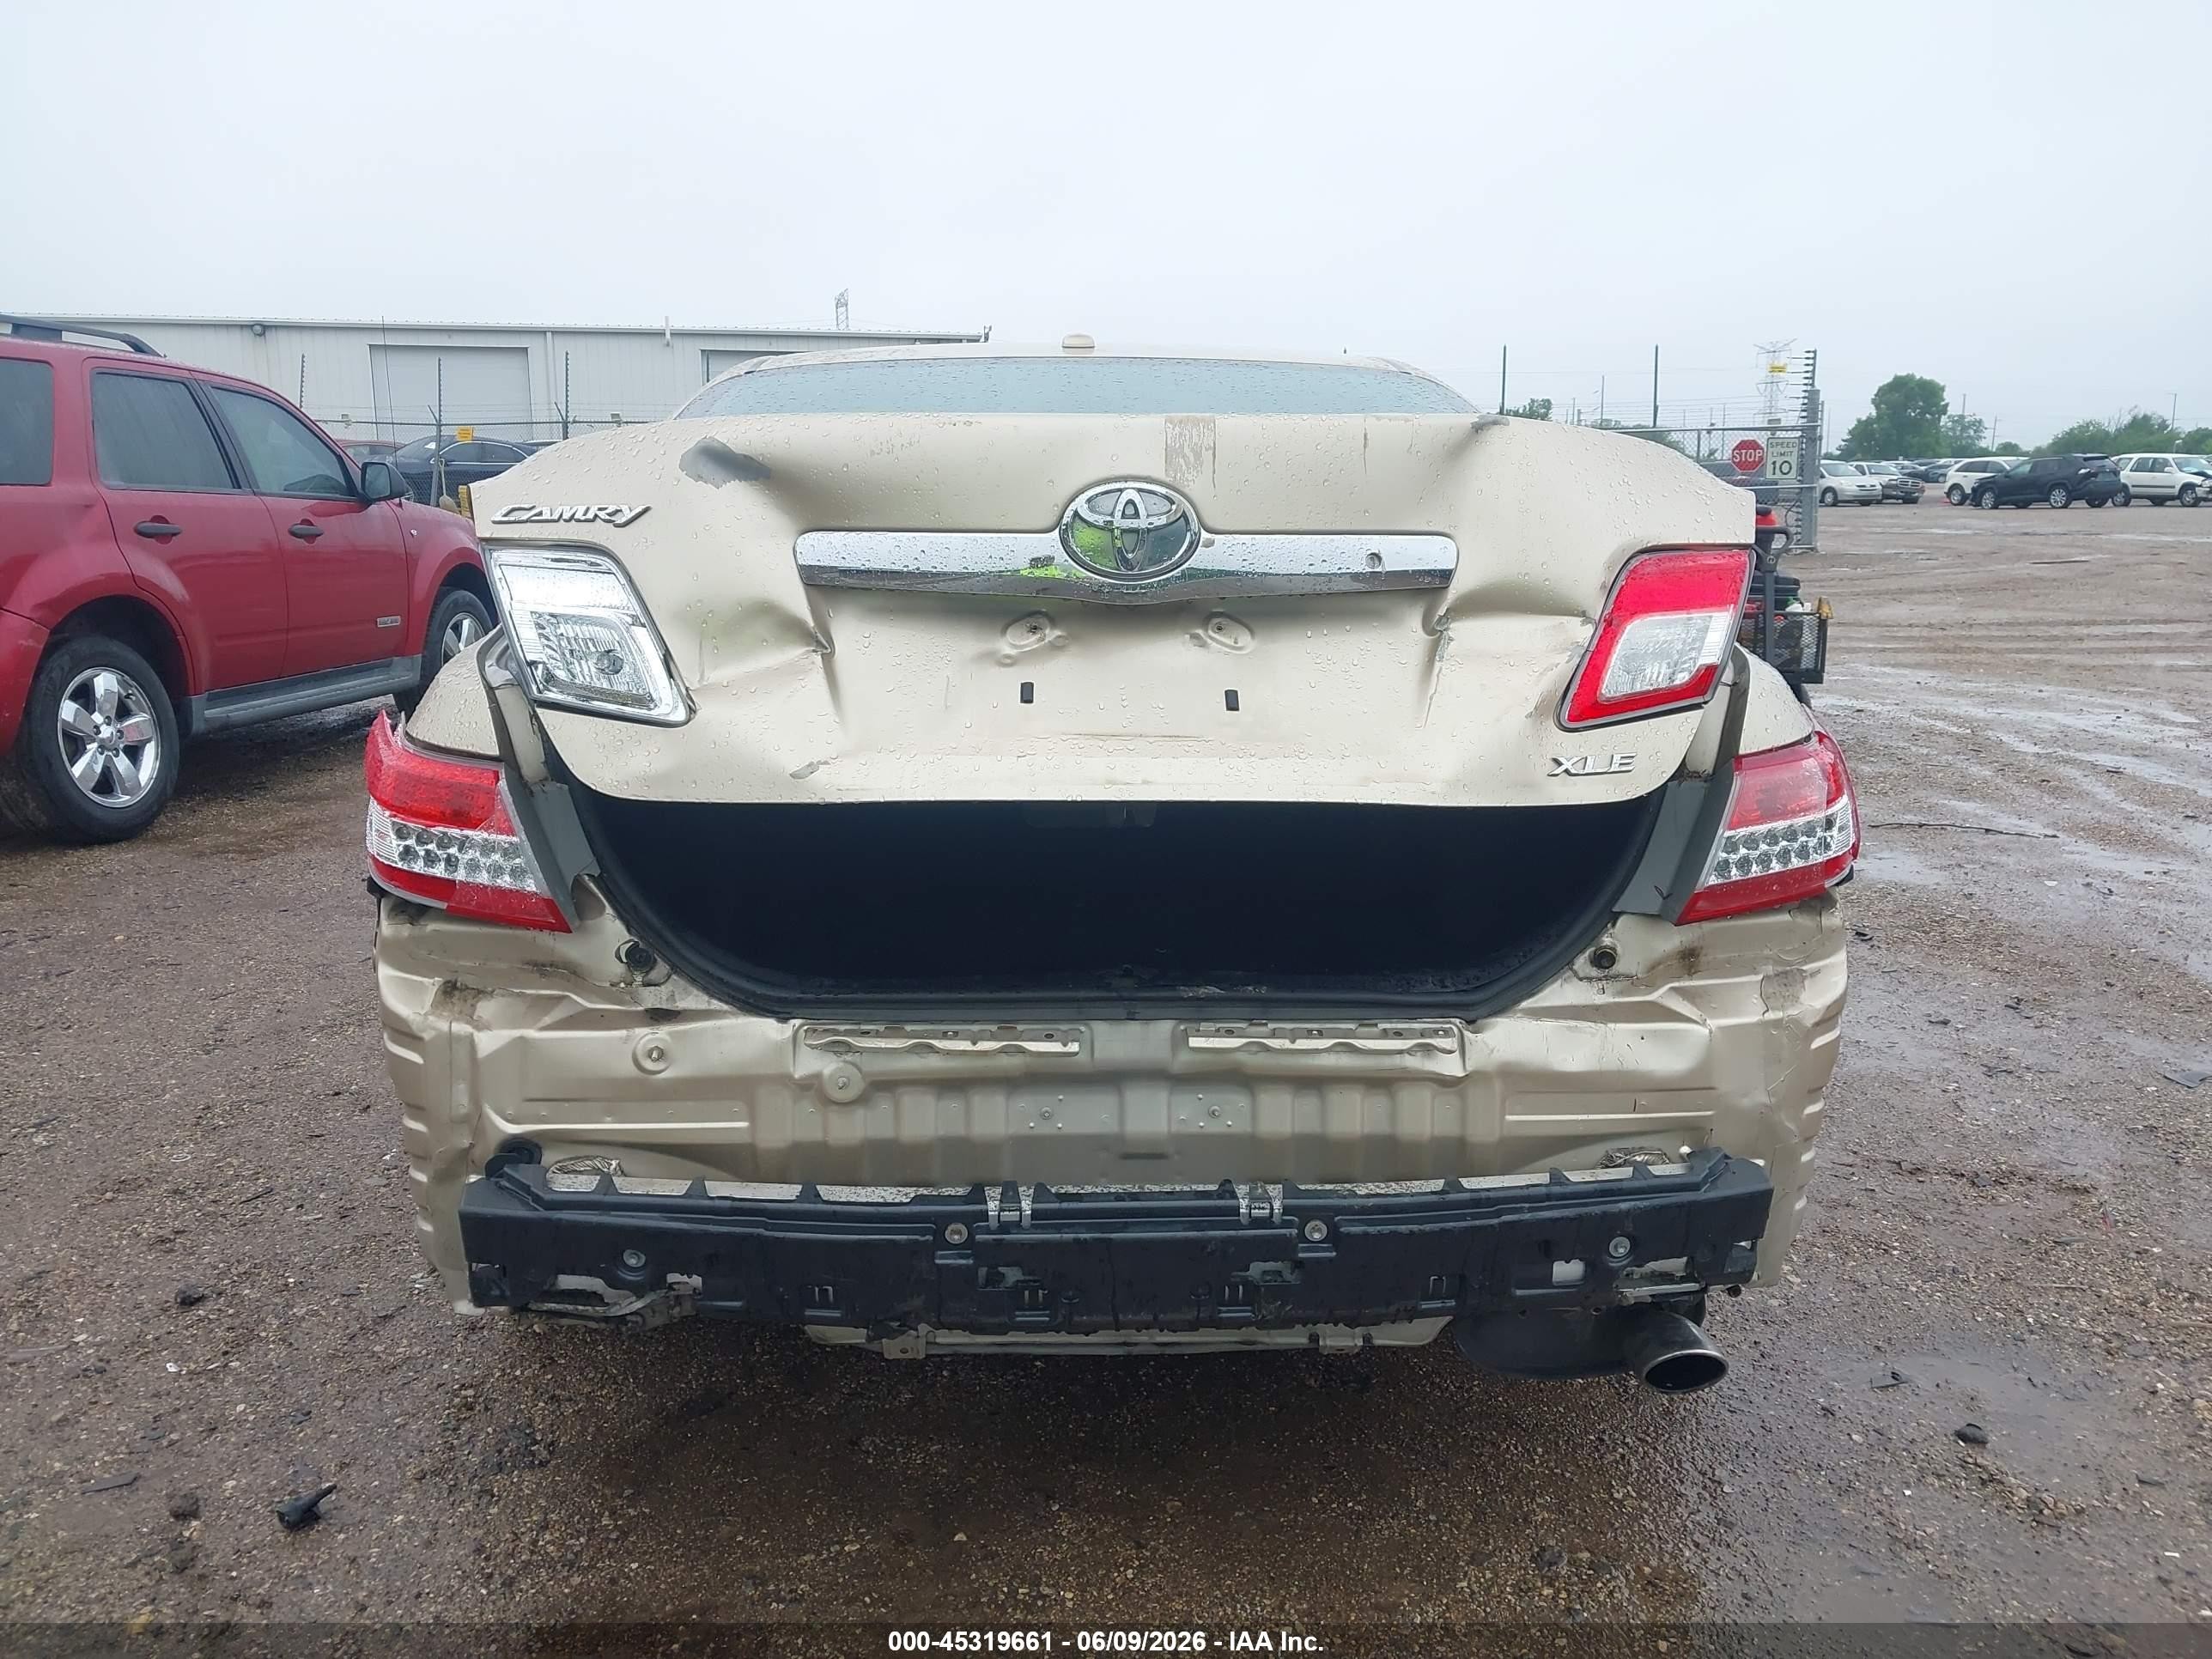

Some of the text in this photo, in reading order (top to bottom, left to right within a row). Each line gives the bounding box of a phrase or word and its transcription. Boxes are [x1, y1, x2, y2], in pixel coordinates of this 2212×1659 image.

[1733, 449, 1763, 462] STOP
[1771, 460, 1792, 475] 10
[490, 503, 653, 528] CAMRY
[1547, 752, 1638, 777] XLE
